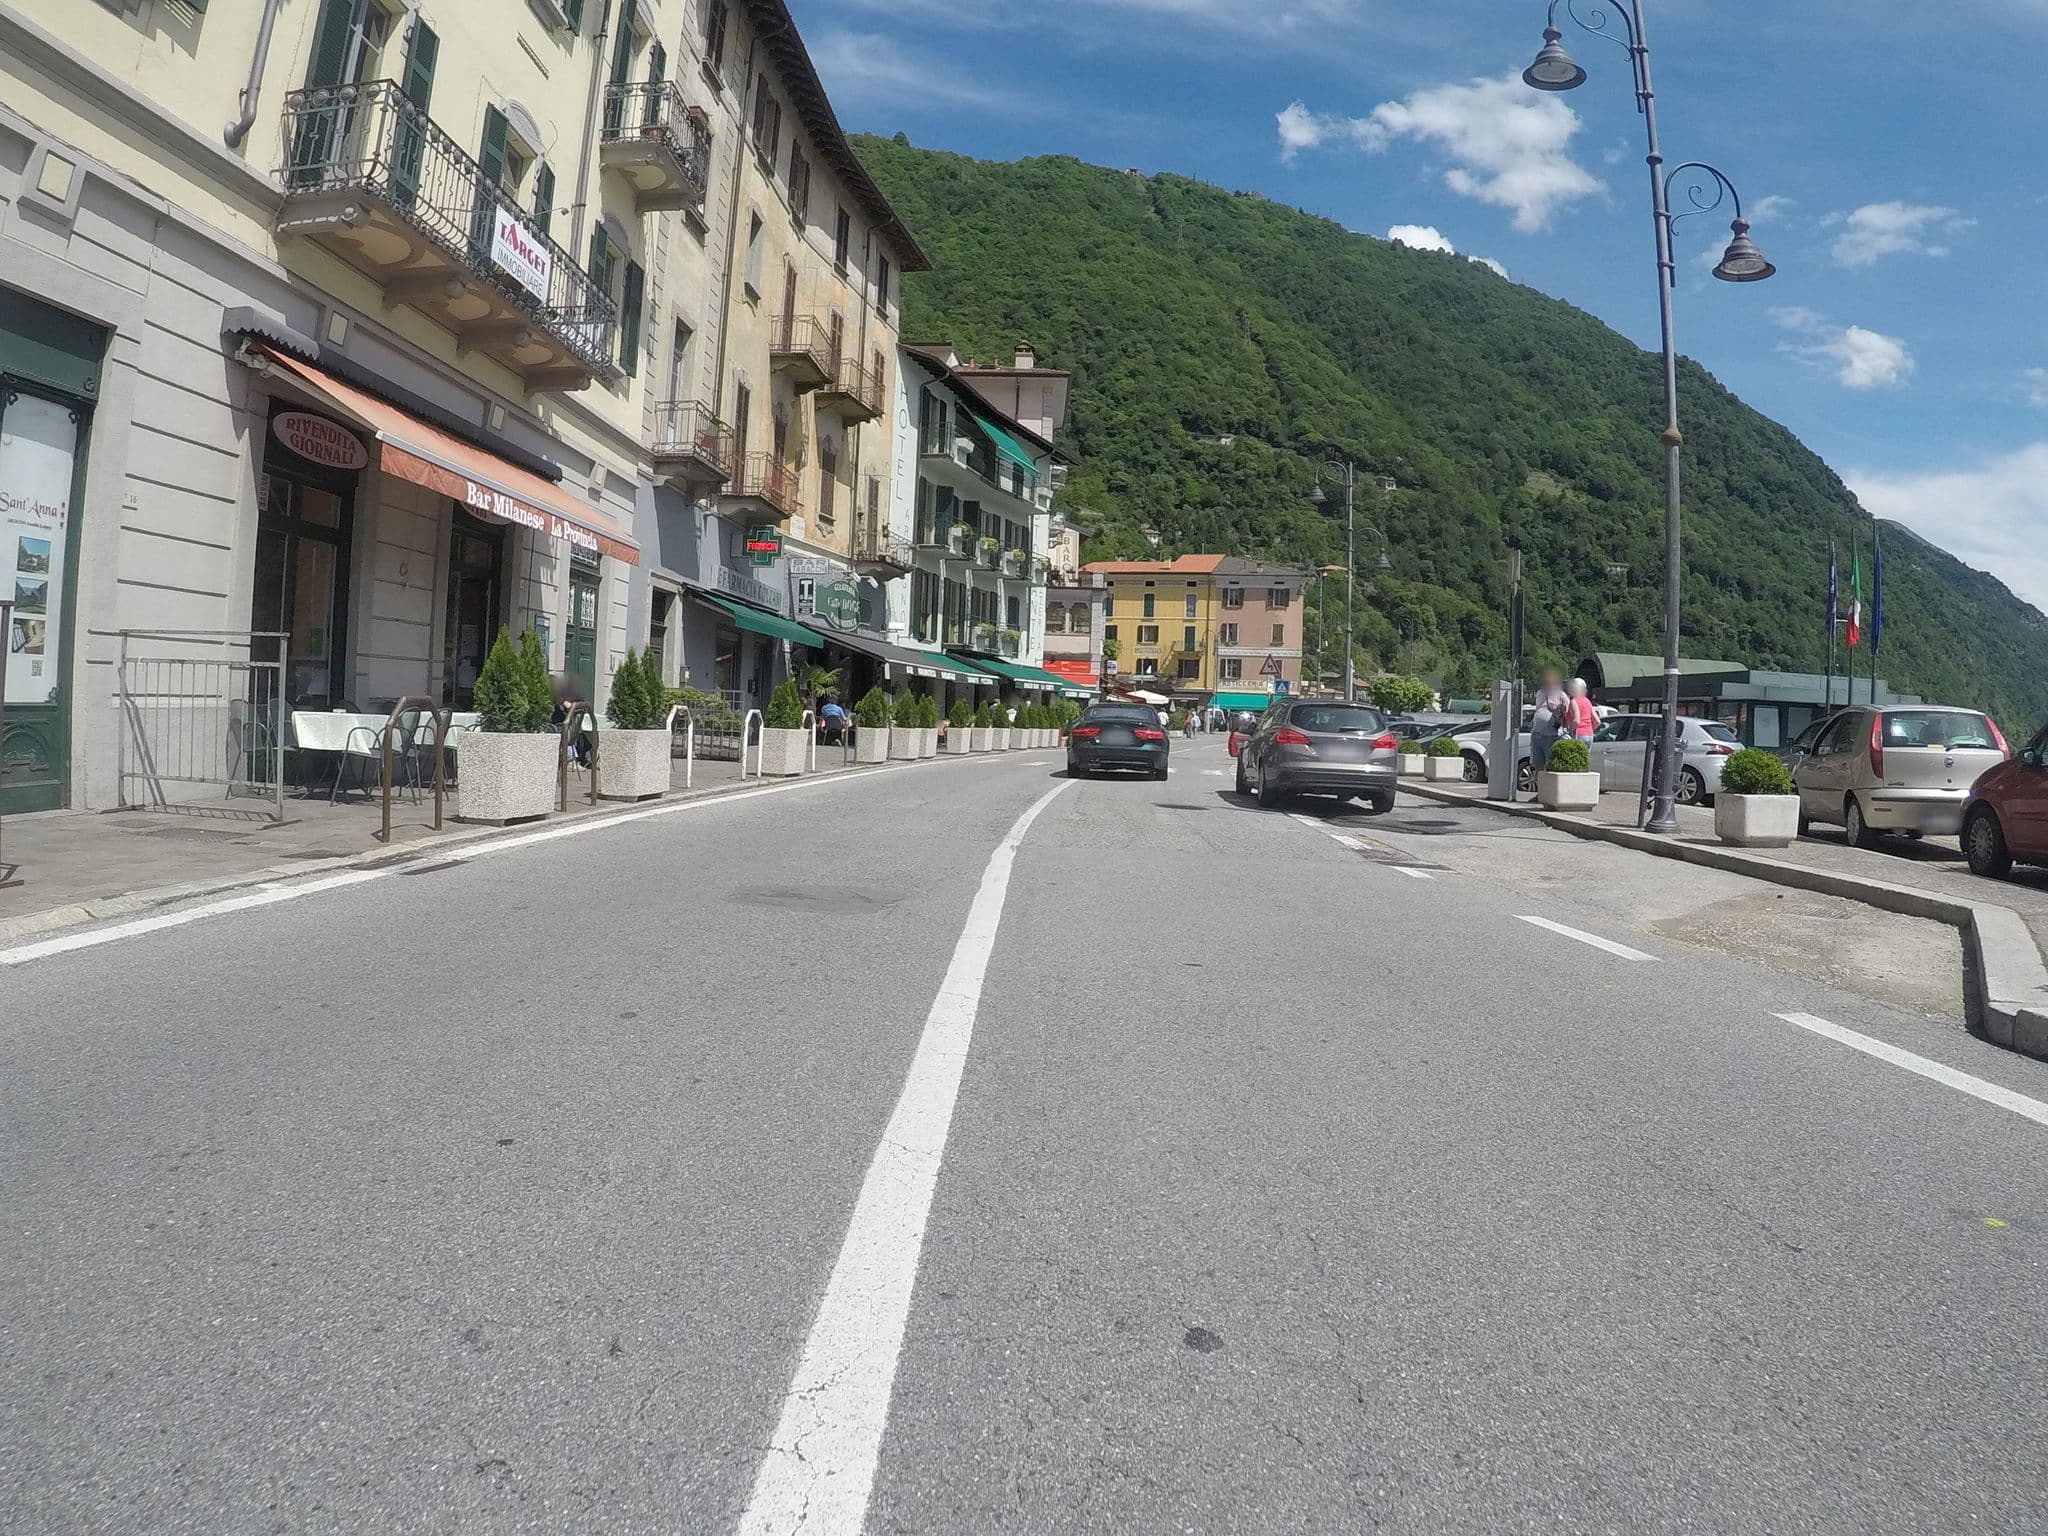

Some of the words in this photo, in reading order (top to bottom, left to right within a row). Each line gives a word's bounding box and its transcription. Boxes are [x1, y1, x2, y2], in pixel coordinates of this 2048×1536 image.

[500, 221, 546, 276] TARGET
[498, 248, 543, 297] IMMOBILIARE
[286, 418, 357, 453] RIVENDITA
[290, 433, 354, 464] GIORNALI
[467, 482, 491, 509] Bar
[493, 492, 545, 531] Milanese
[551, 516, 562, 538] La
[793, 565, 827, 573] TABACCHI
